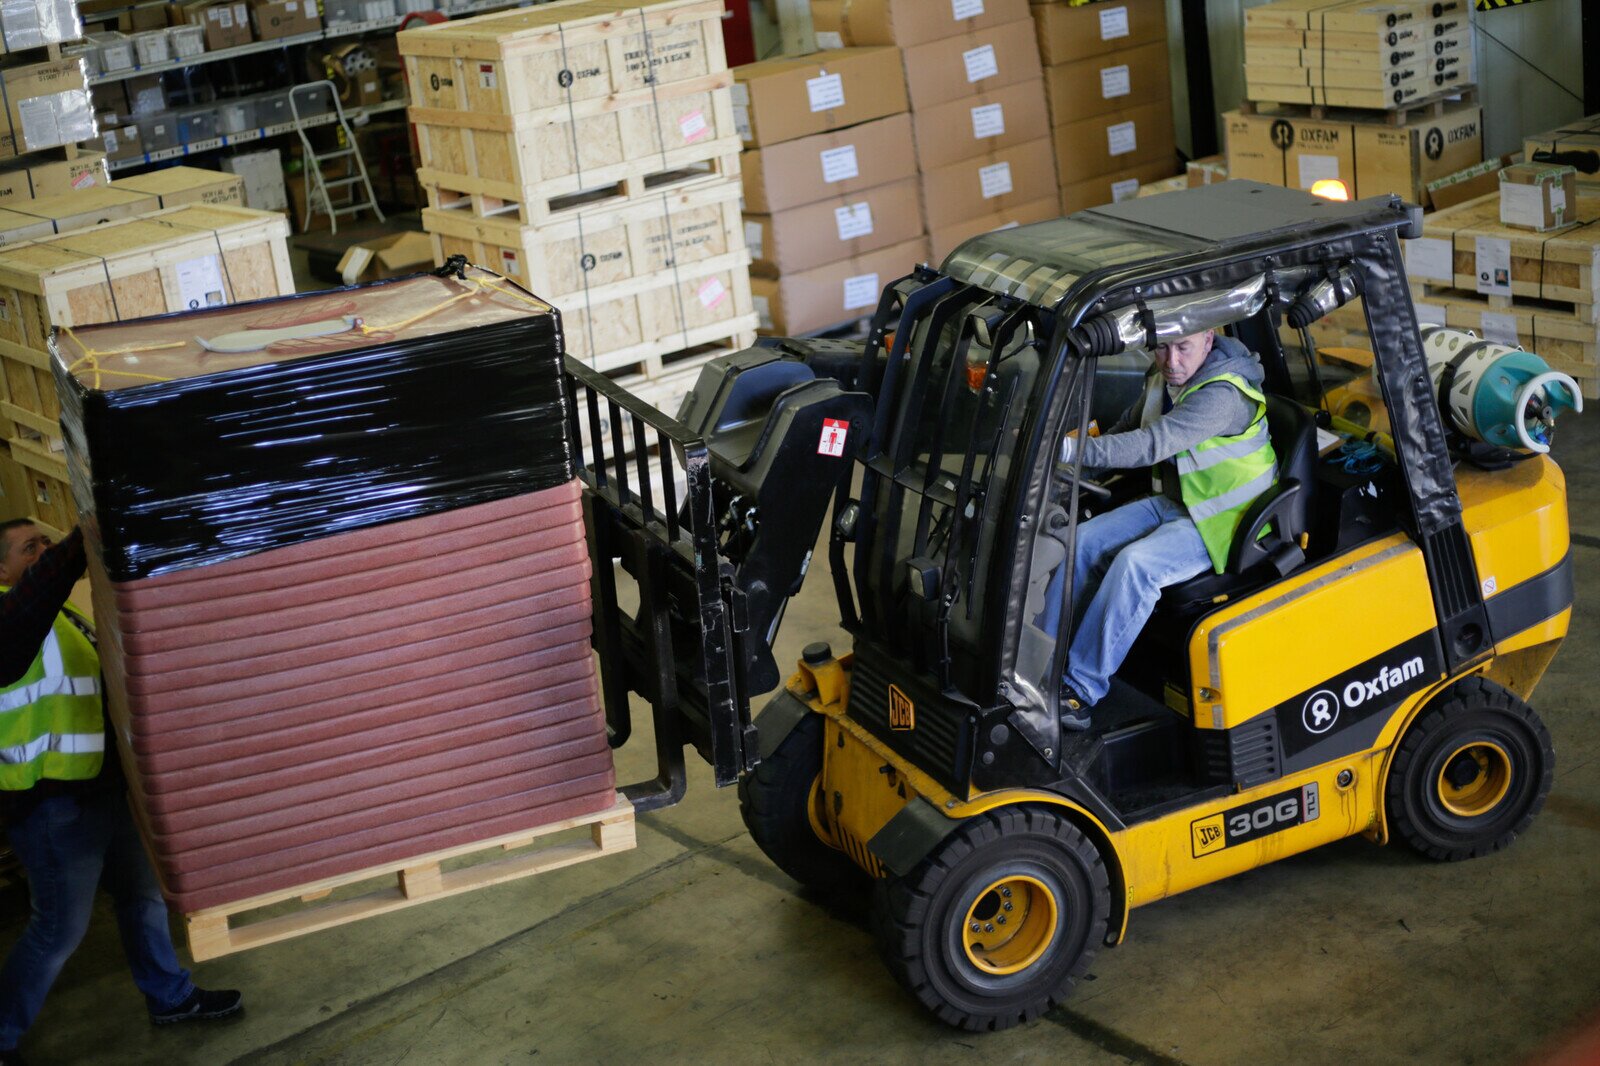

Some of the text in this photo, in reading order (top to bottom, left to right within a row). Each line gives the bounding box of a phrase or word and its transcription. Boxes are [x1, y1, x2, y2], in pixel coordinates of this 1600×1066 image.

[1301, 128, 1339, 143] OXFAM
[1448, 123, 1477, 143] OXFAM
[1343, 656, 1425, 708] Oxfam
[892, 691, 911, 726] JCB
[1229, 790, 1315, 837] 30G TLT
[1200, 826, 1221, 845] JCB
